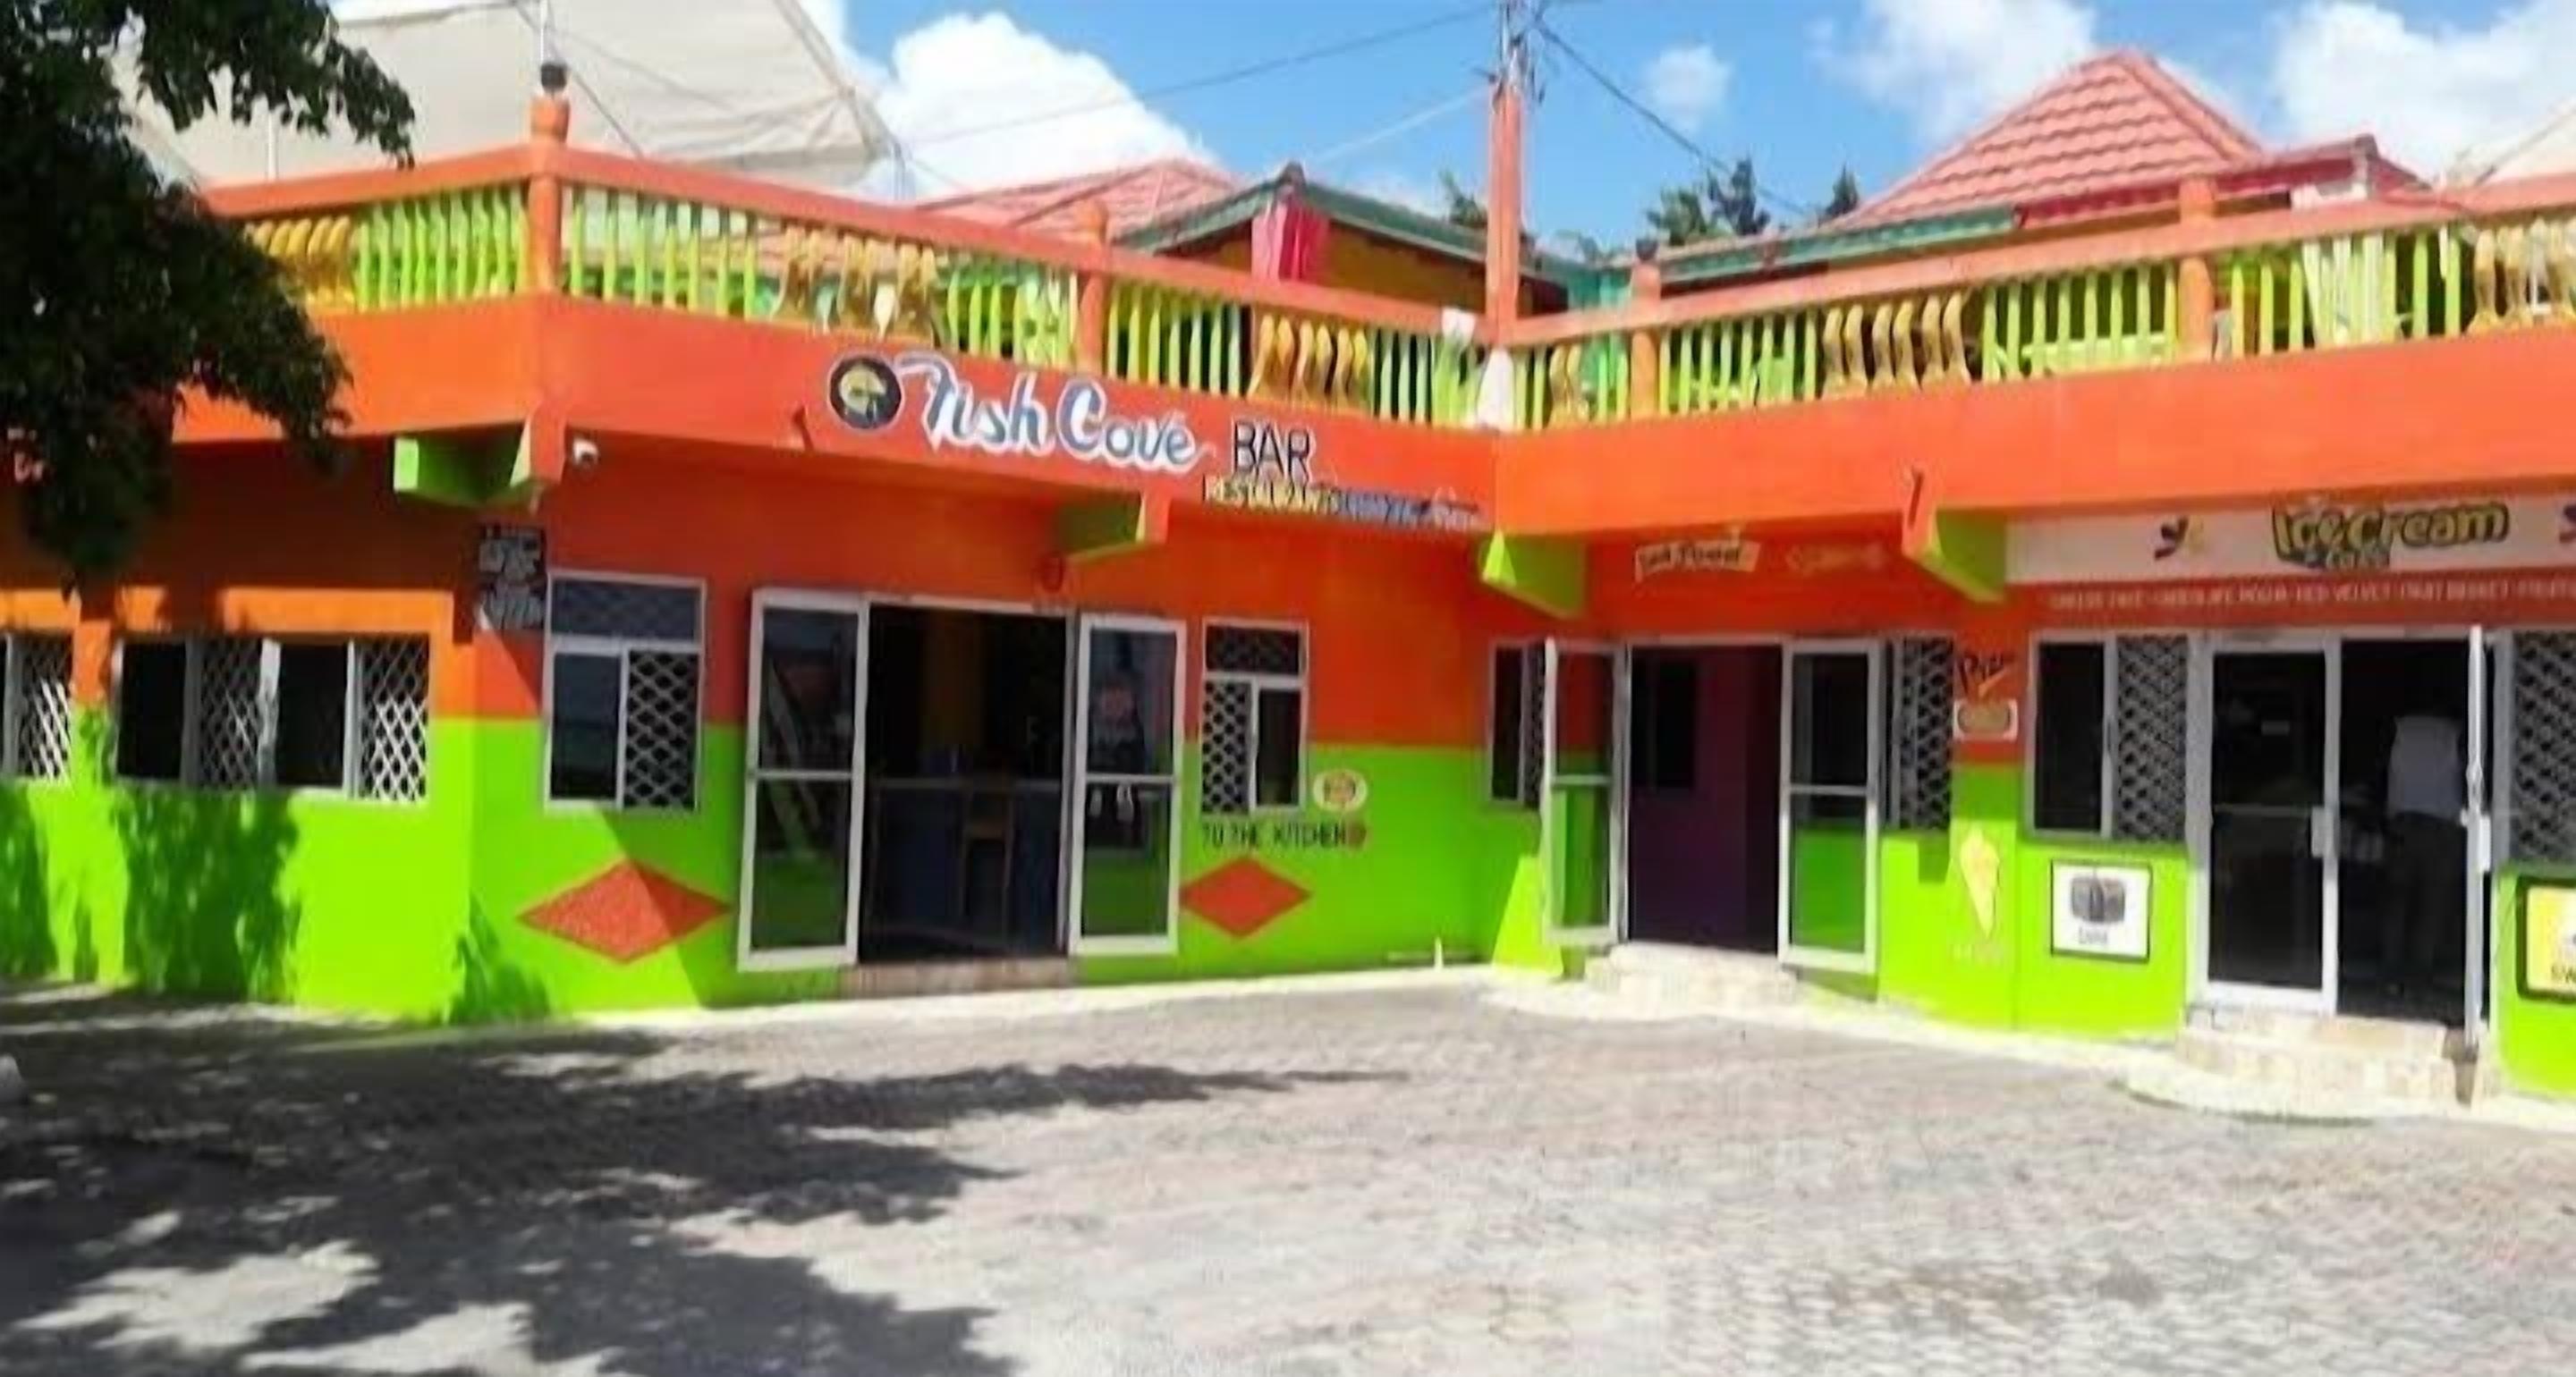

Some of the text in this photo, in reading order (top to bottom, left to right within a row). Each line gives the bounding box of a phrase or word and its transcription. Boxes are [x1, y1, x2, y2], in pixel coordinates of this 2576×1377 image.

[1056, 376, 1201, 474] Cove
[1231, 417, 1317, 488] BAR
[2343, 503, 2510, 551] Cream
